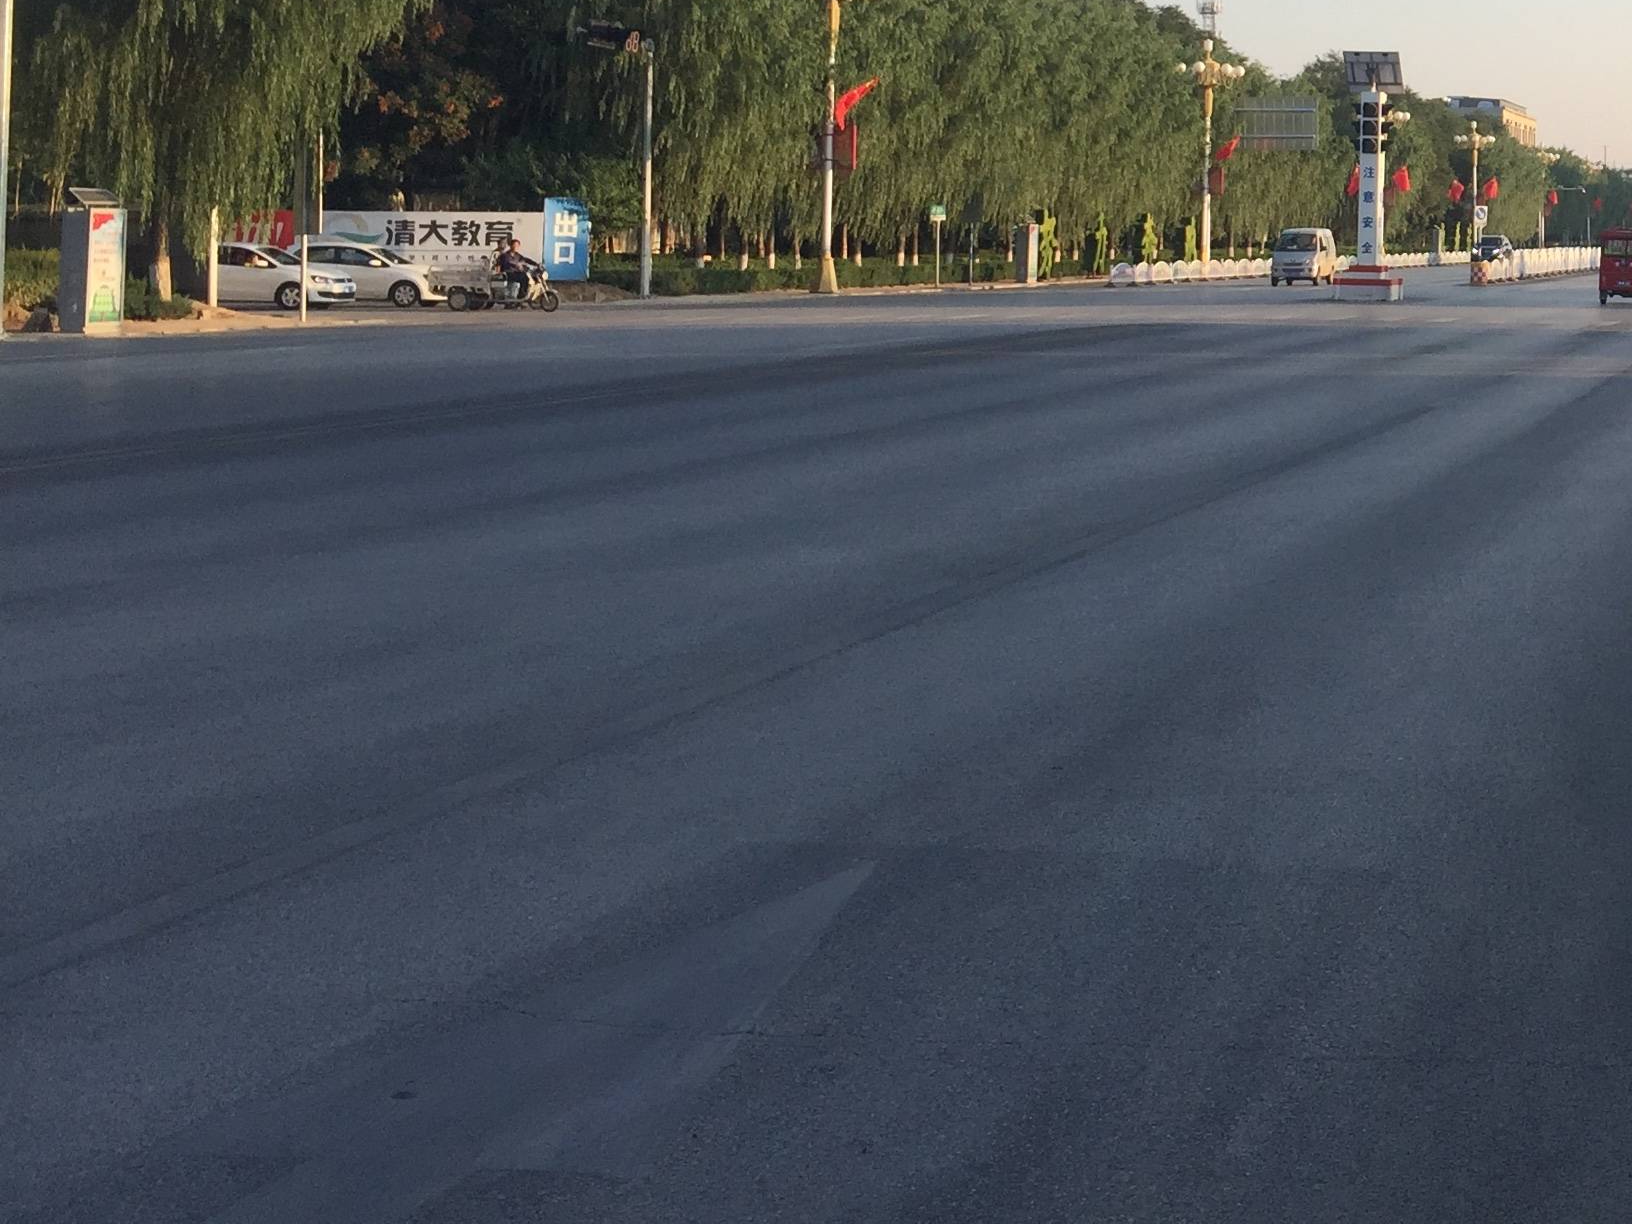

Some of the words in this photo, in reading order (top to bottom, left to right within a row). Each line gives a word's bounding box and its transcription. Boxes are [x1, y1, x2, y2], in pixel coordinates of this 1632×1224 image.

[385, 219, 514, 246] 清大教育
[553, 210, 578, 265] 出口
[1361, 166, 1376, 254] 注意安全
